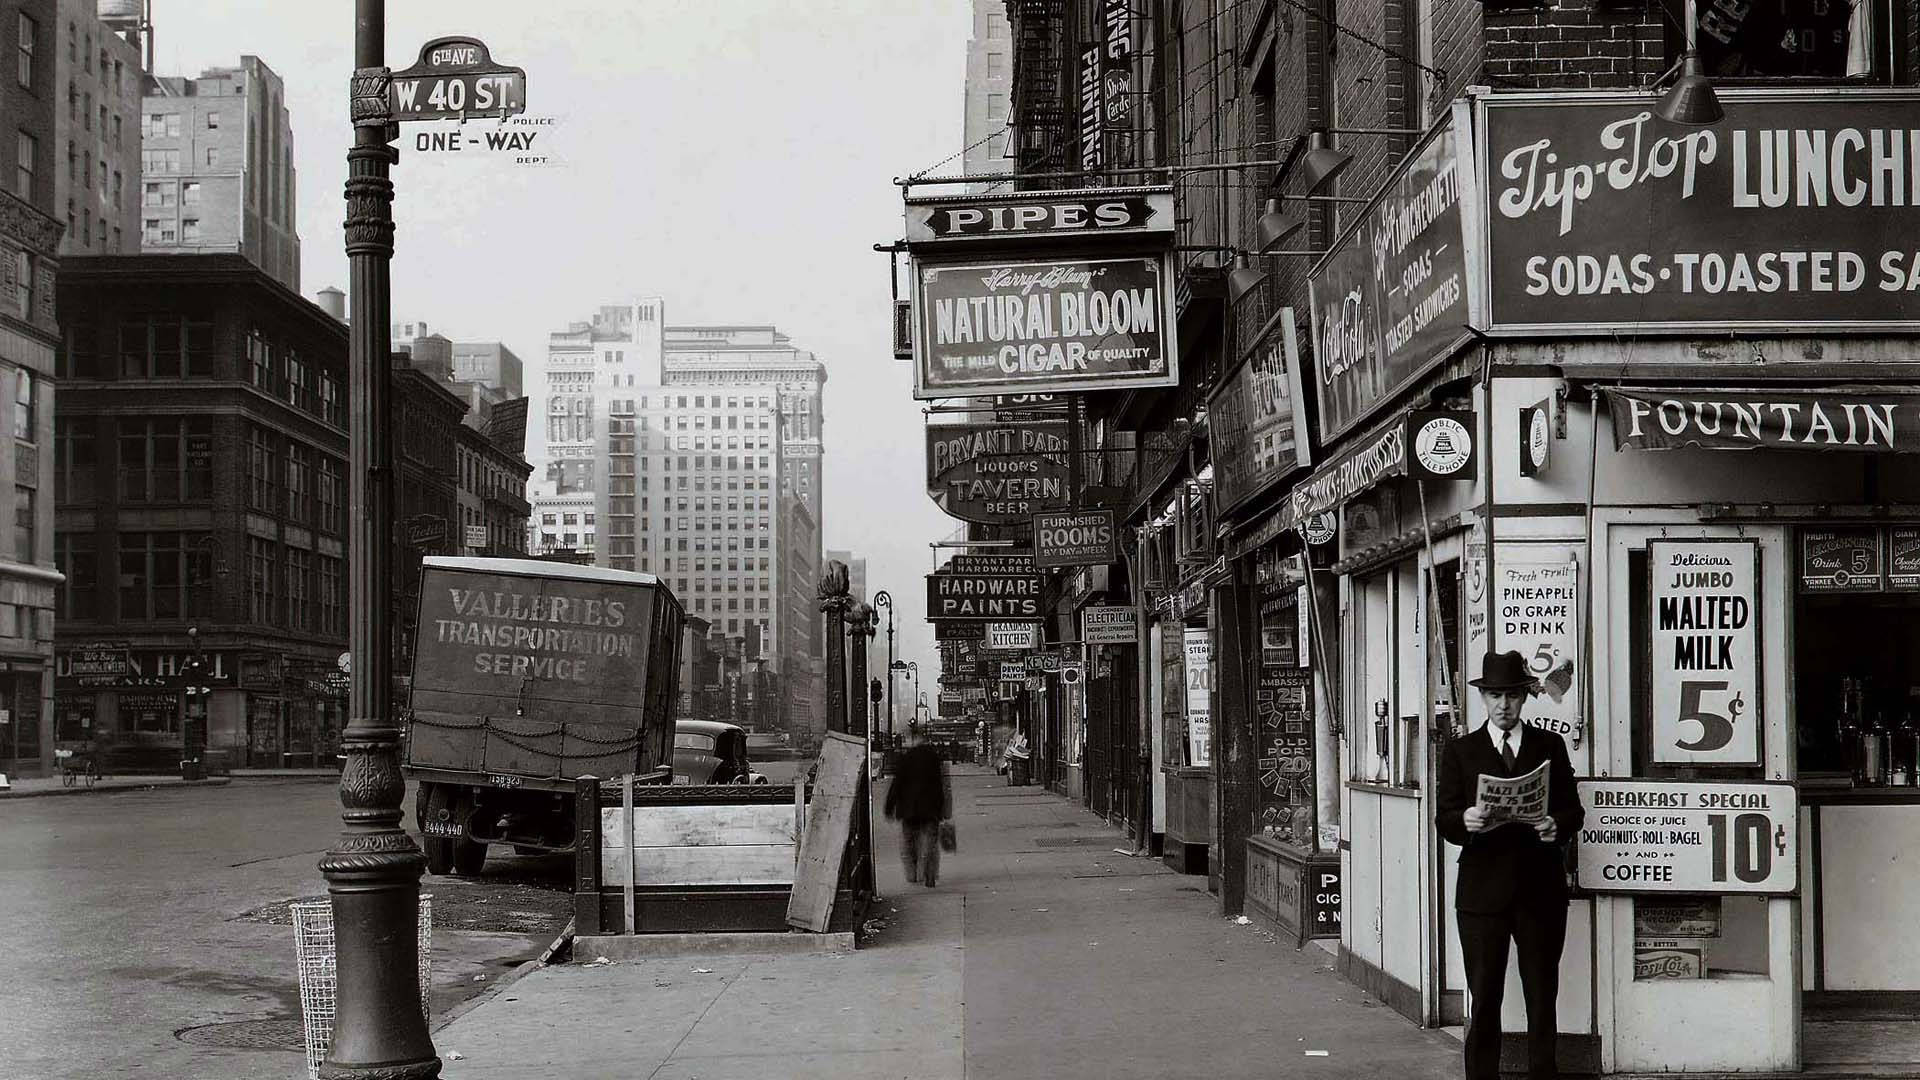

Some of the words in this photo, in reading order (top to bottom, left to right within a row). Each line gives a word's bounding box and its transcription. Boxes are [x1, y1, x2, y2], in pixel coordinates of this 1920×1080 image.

[432, 48, 450, 66] 6TH
[450, 48, 478, 65] AVE.
[394, 80, 422, 112] W.
[428, 79, 466, 110] 40
[475, 77, 516, 110] ST.
[1082, 47, 1100, 171] PRINTING
[1107, 98, 1129, 122] Cards
[1499, 111, 1717, 237] Tip-Top
[945, 202, 1132, 234] PIPES
[1402, 249, 1432, 297] SODAS
[980, 270, 1040, 296] Harry
[935, 293, 1059, 345] NATURAL
[1062, 287, 1155, 338] BLOOM
[1385, 313, 1413, 357] TOASTED
[1414, 273, 1460, 334] SANDWICHES
[941, 355, 965, 369] THE
[998, 342, 1088, 374] CIGAR
[1088, 350, 1102, 361] OF
[1103, 347, 1150, 360] QUALITY
[1424, 418, 1463, 433] PUBLIC
[1628, 399, 1899, 448] FOUNTAIN
[934, 429, 1015, 478] BRYANT
[1419, 451, 1469, 473] TELEPHONE
[975, 461, 1039, 473] LIQUORS
[950, 478, 1060, 500] TAVERN
[986, 502, 1030, 514] BEER
[1042, 516, 1106, 528] FURNISHED
[1039, 526, 1111, 548] ROOMS
[957, 557, 1004, 565] BRYANT
[1008, 557, 1031, 565] PAR
[1043, 548, 1057, 557] BY
[1059, 547, 1075, 556] DAY
[1670, 553, 1733, 567] Delicious
[957, 565, 1022, 573] HARDWARE
[1812, 557, 1843, 568] Drink
[1506, 569, 1537, 582] Fresh
[1541, 567, 1569, 579] Fruit
[1671, 572, 1733, 588] JUMBO
[939, 579, 1039, 595] HARDWARE
[1503, 588, 1574, 600] PINEAPPLE
[449, 588, 626, 628] VALLERIE'S
[943, 600, 1037, 615] PAINTS
[1502, 606, 1520, 617] OR
[1525, 606, 1567, 617] GRAPE
[1659, 596, 1749, 631] MALTED
[1505, 622, 1565, 635] DRINK
[435, 619, 633, 657] TRANSPORTATION
[991, 633, 1031, 645] KITCHEN
[1674, 636, 1734, 670] MILK
[474, 653, 588, 681] SERVICE
[1273, 738, 1308, 746] OLD
[1487, 785, 1512, 795] NAZI
[1593, 790, 1688, 807] BREAKFAST
[1699, 793, 1770, 808] SPECIAL
[1506, 796, 1519, 805] 75
[1600, 815, 1641, 825] CHOICE
[1643, 816, 1657, 825] OF
[1660, 816, 1687, 825] JUICE
[1602, 864, 1673, 882] COFFEE
[1316, 893, 1340, 904] CIG
